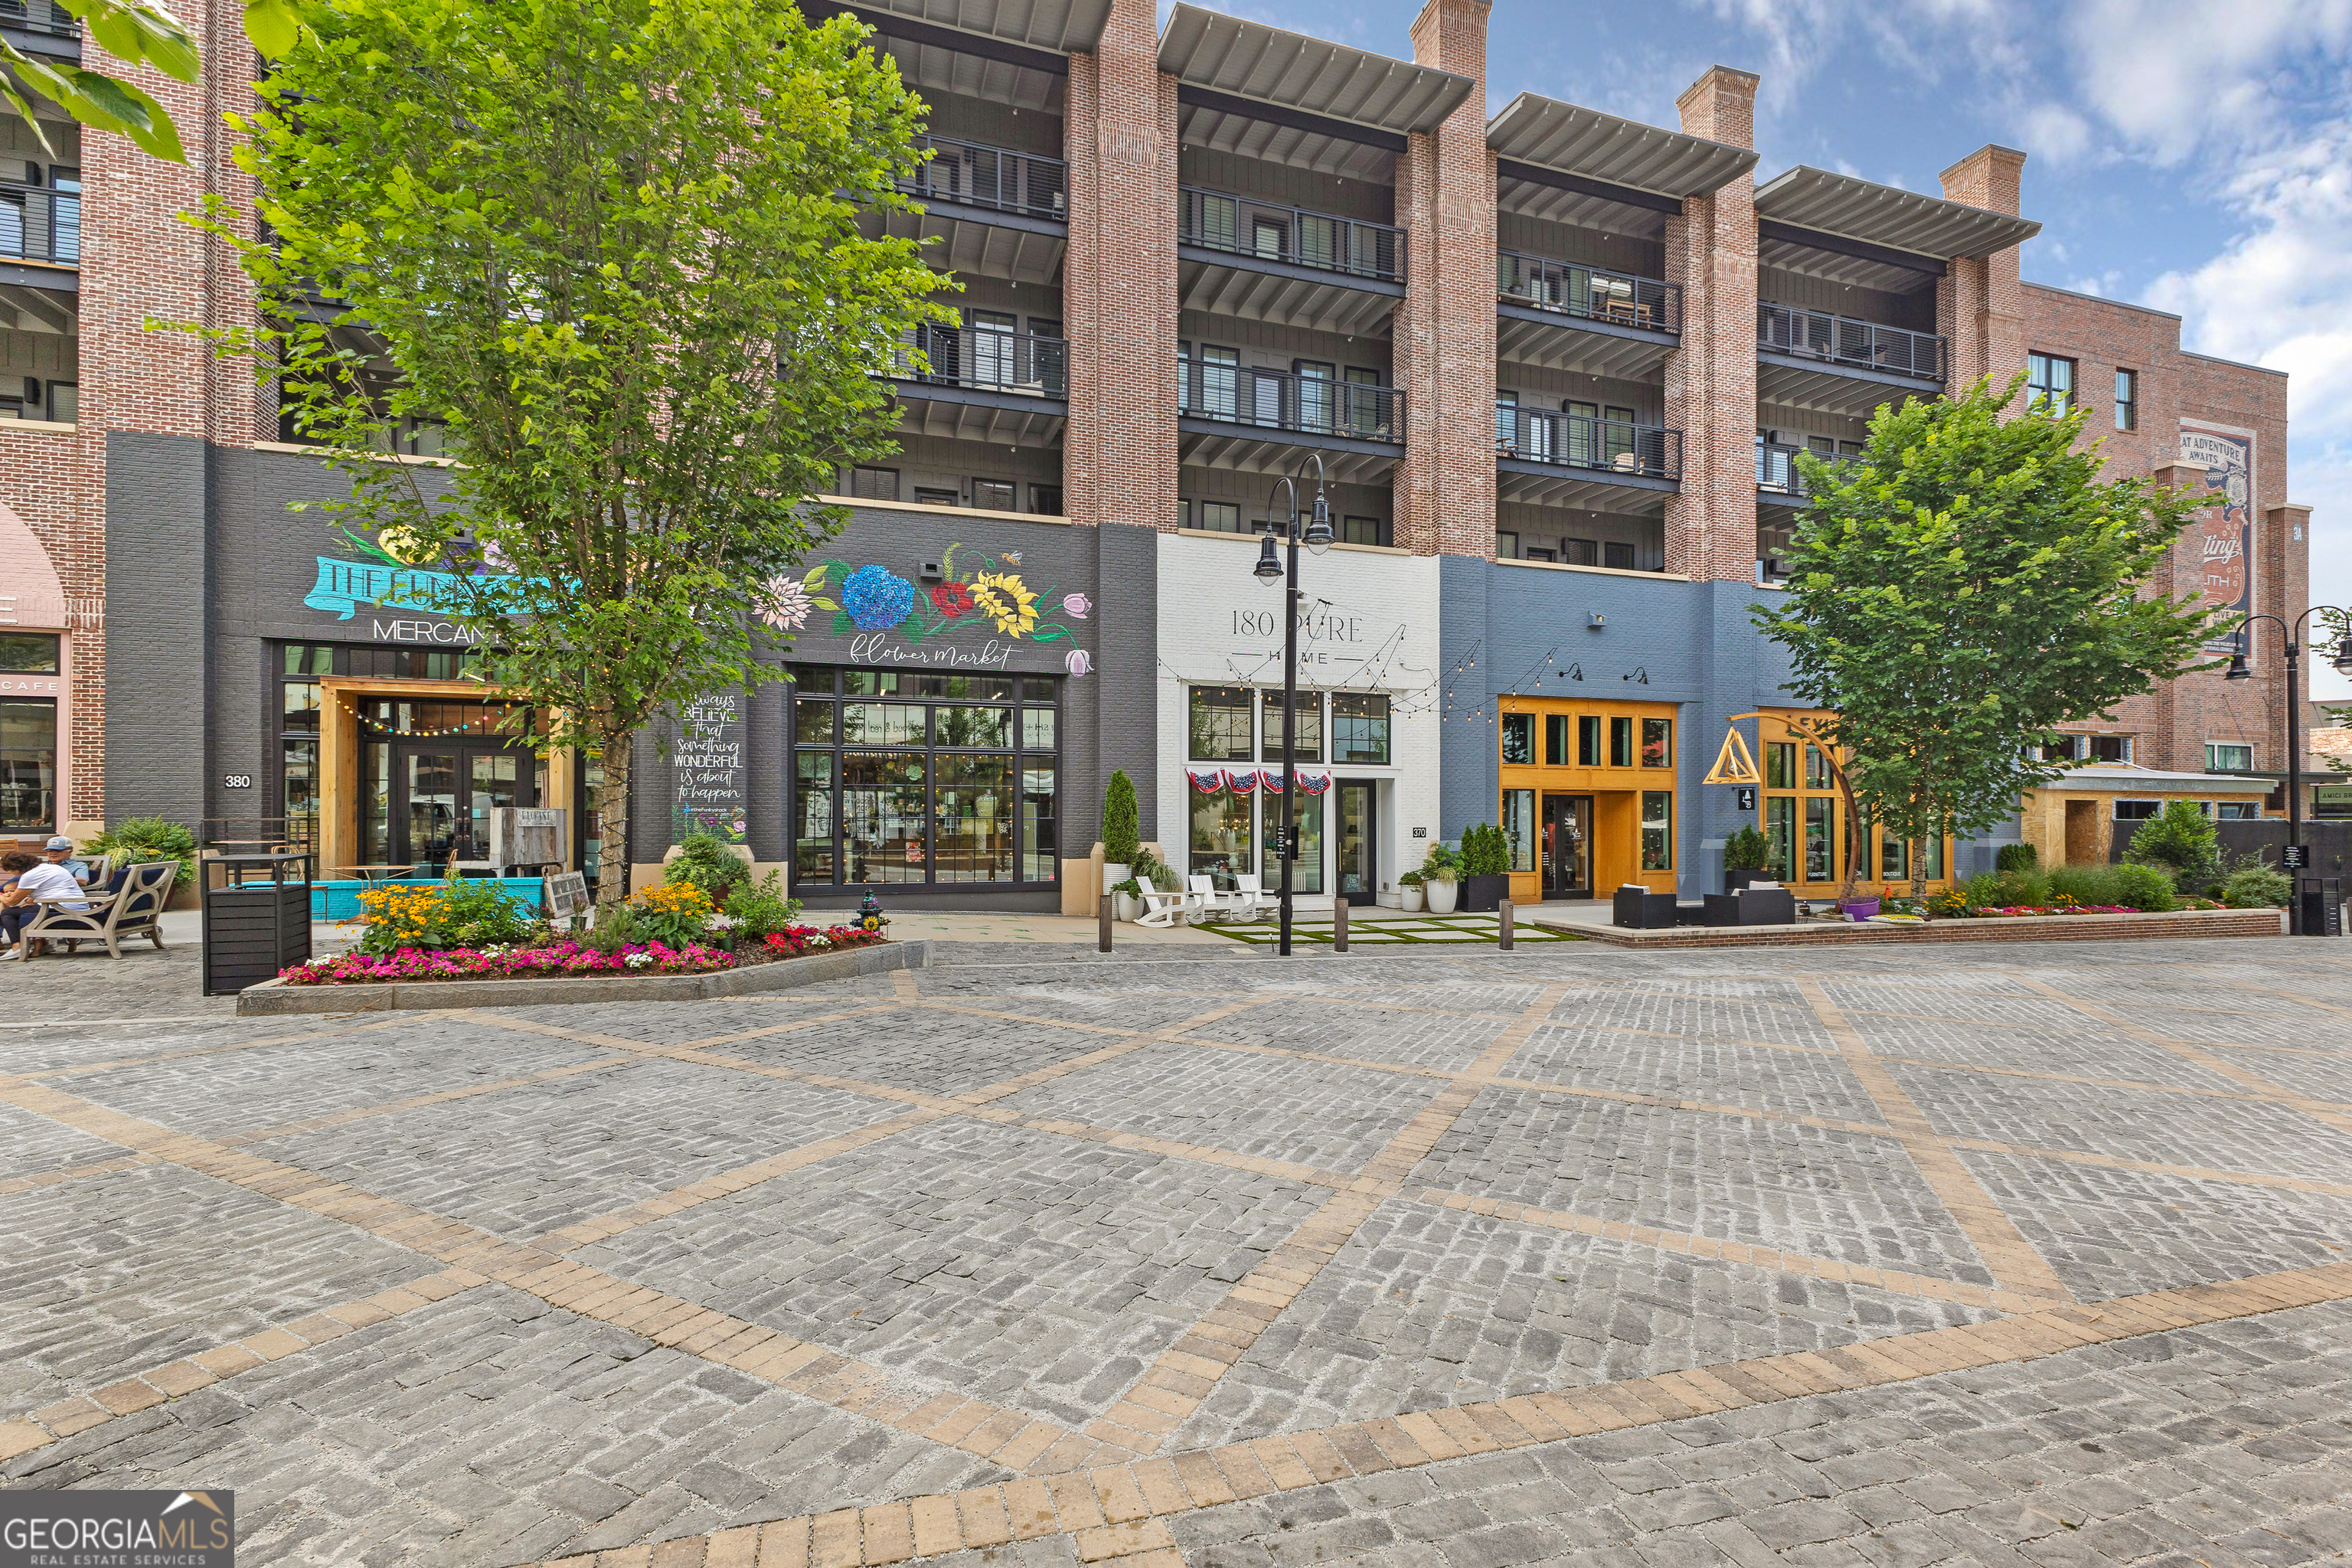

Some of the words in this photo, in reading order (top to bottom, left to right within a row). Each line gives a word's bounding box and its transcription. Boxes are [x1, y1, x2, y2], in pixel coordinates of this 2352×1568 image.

[2188, 451, 2219, 464] AWAITS
[2194, 438, 2240, 462] ADVENTURE
[2293, 527, 2302, 541] 3A
[323, 562, 384, 599] THE
[2213, 610, 2230, 619] LIVE
[1233, 610, 1274, 637] 180
[850, 632, 929, 664] flower
[1269, 650, 1328, 665] HME
[1, 681, 58, 691] CAFE
[683, 706, 736, 723] BELIEVE
[691, 721, 733, 740] that
[675, 754, 743, 768] WONDERFUL
[225, 775, 250, 788] 380
[681, 768, 693, 786] is
[697, 769, 737, 788] about
[677, 784, 692, 802] to
[691, 784, 741, 803] happen
[1413, 828, 1426, 837] 370
